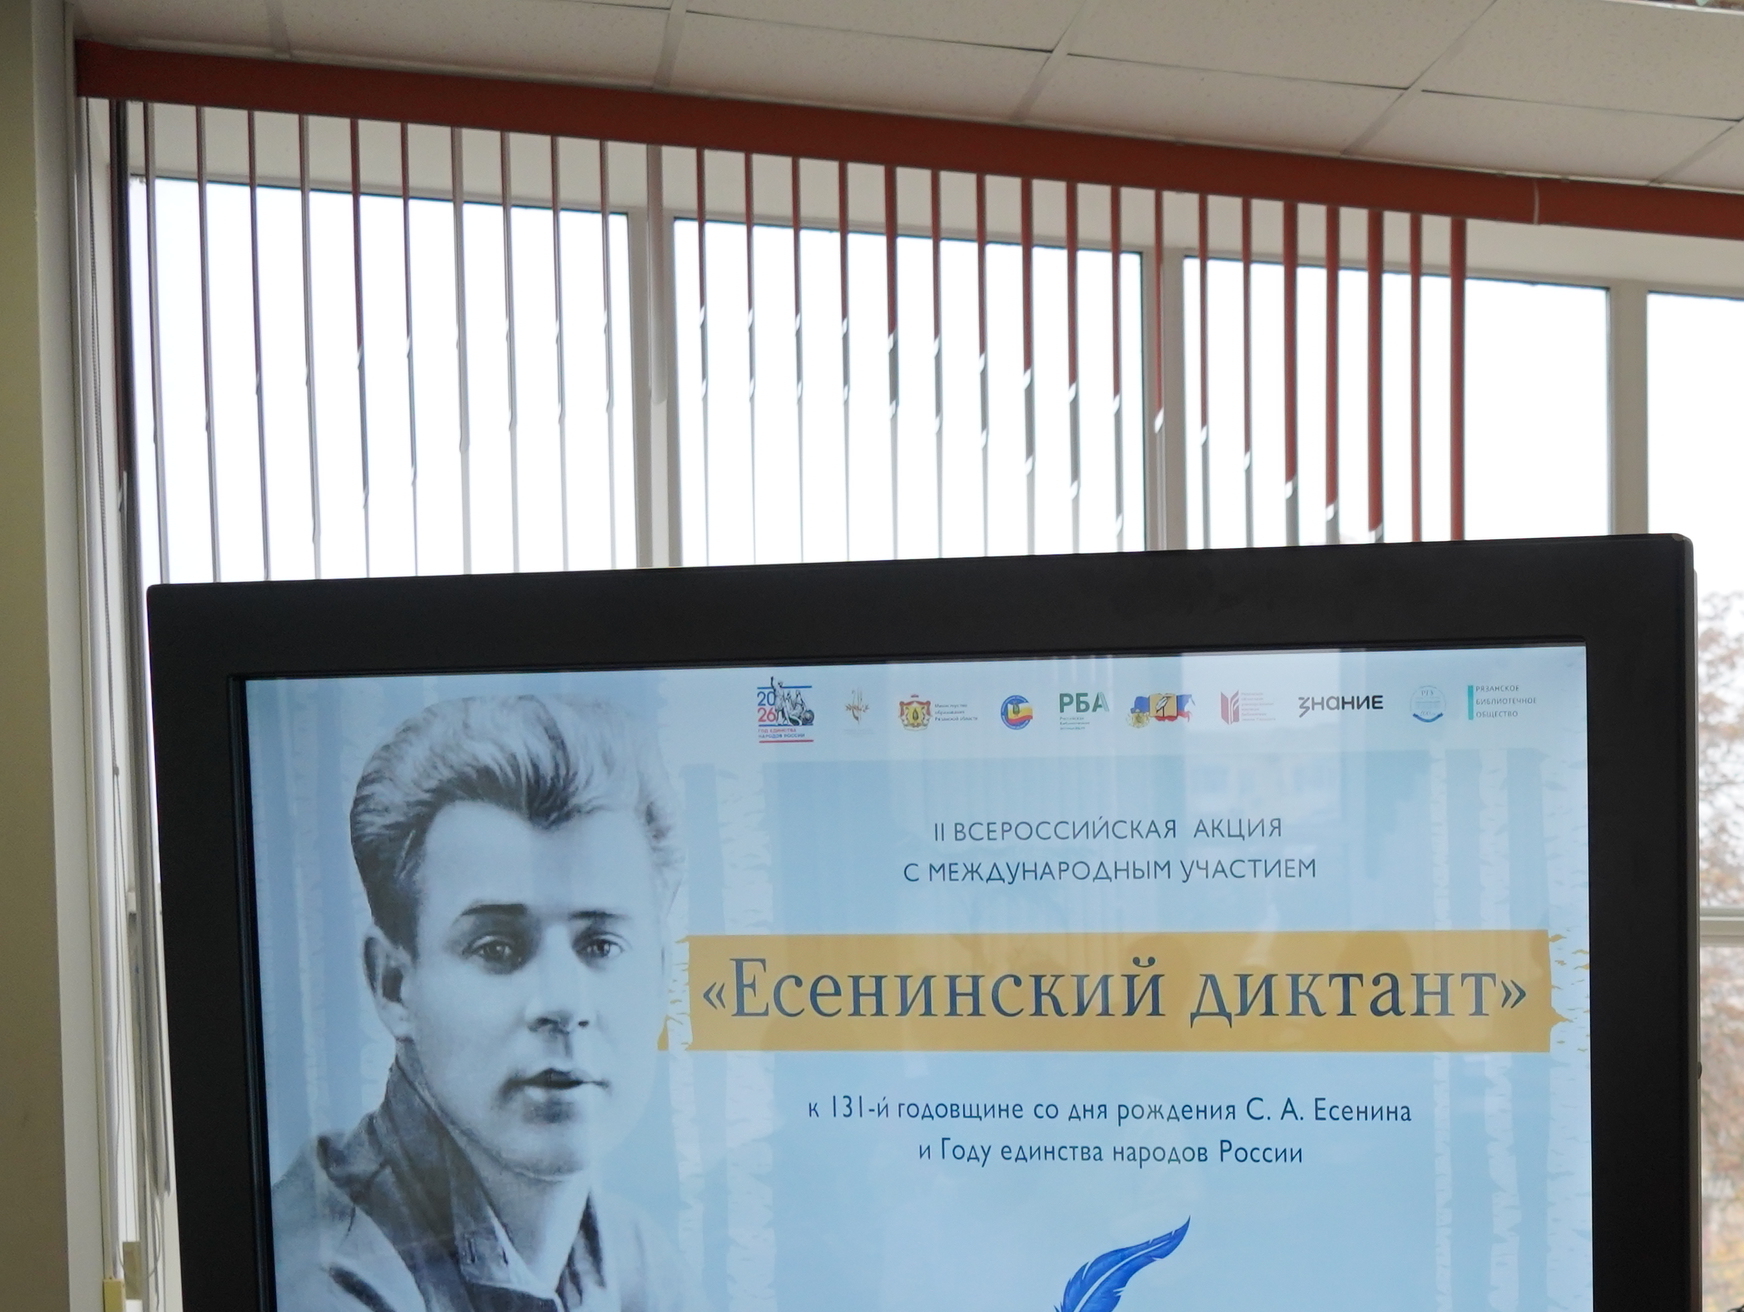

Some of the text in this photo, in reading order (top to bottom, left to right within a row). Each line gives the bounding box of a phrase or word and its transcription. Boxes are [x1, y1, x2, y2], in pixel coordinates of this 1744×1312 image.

[757, 691, 776, 707] 20
[1059, 692, 1110, 713] РБА
[1475, 697, 1537, 705] БИБЛИОТЕЧНОЕ
[757, 707, 777, 722] 26
[1475, 710, 1519, 718] ОБЩЕСТВО
[955, 816, 1177, 842] ВСЕРОССИЙСКАЯ
[1193, 818, 1282, 842] АКЦИЯ
[904, 859, 1316, 885] С МЕЖДУНАРОДНЫМ УЧАСТИЕМ
[703, 957, 1527, 1028] «Есенинский диктант»
[809, 1095, 1412, 1127] к 131-й годовщине со дня рождения С. А. Есенина
[918, 1137, 1303, 1169] и Году единства народов России
